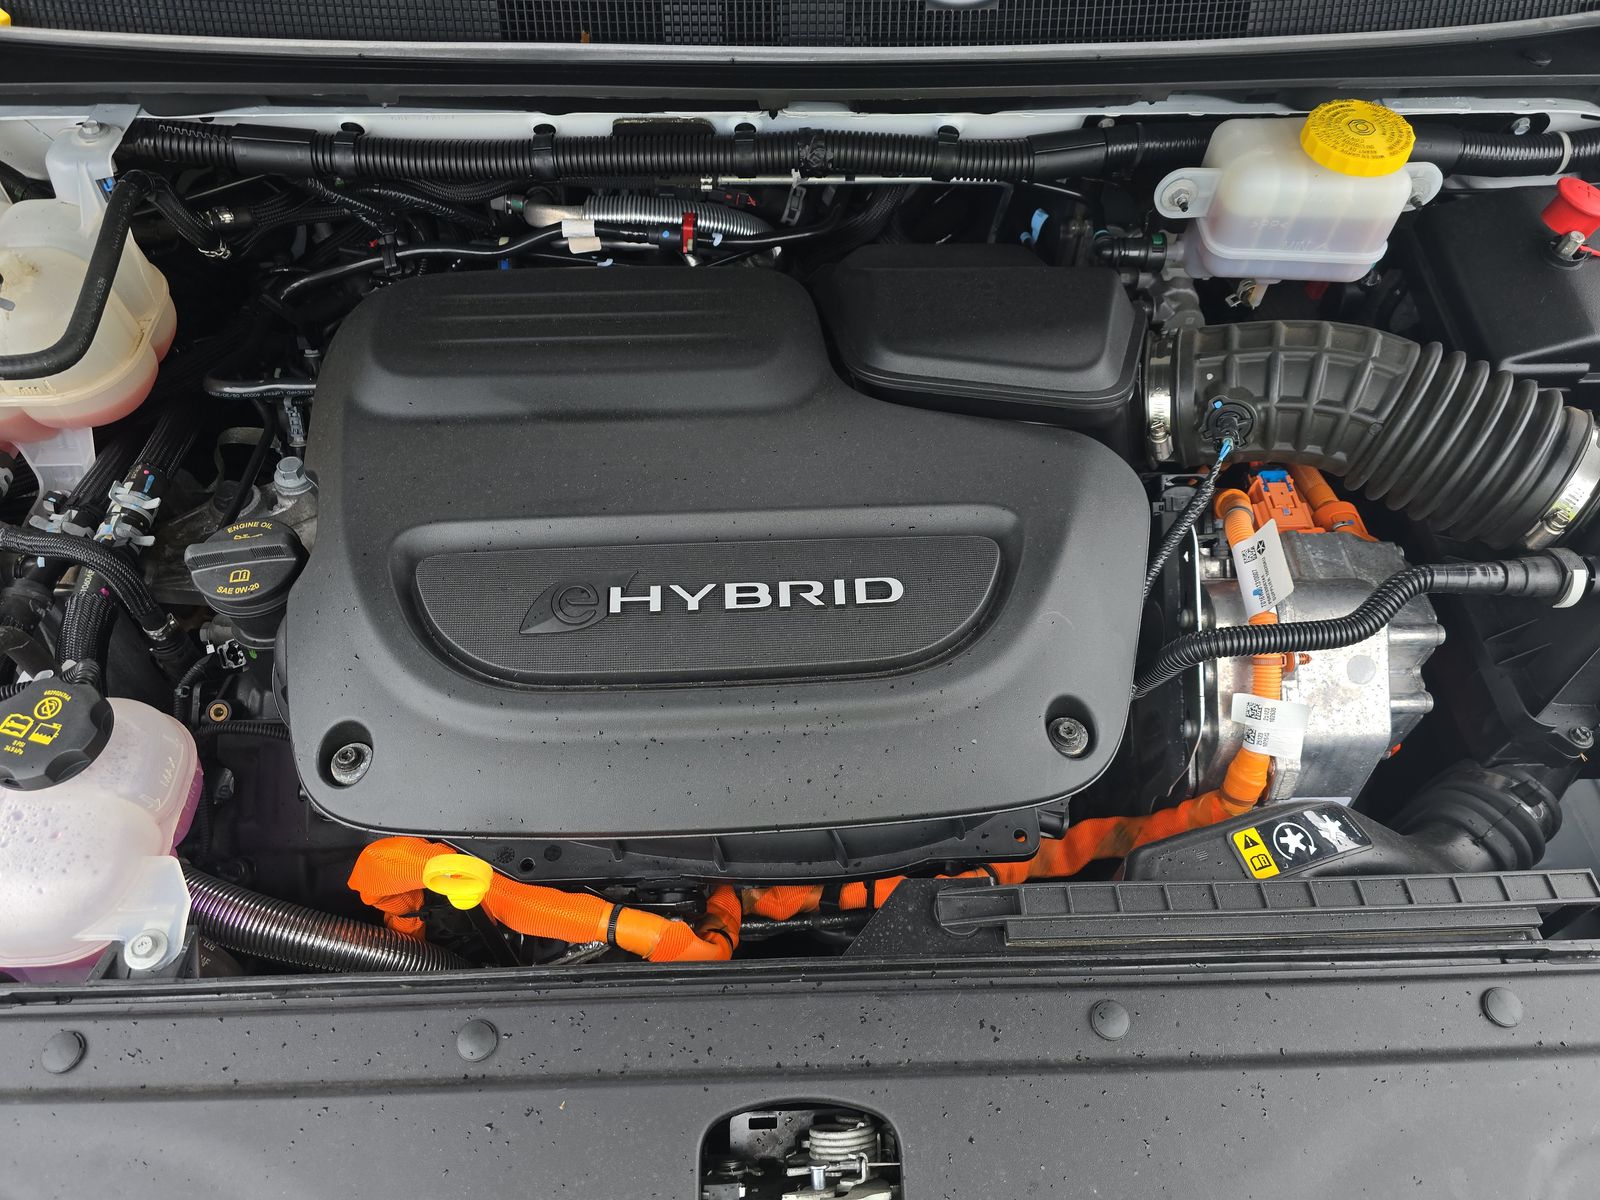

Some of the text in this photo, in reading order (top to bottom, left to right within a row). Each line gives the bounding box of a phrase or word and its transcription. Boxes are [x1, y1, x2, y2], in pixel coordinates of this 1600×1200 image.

[226, 521, 273, 534] ENGINE OIL
[216, 582, 260, 595] SAE 0W-20
